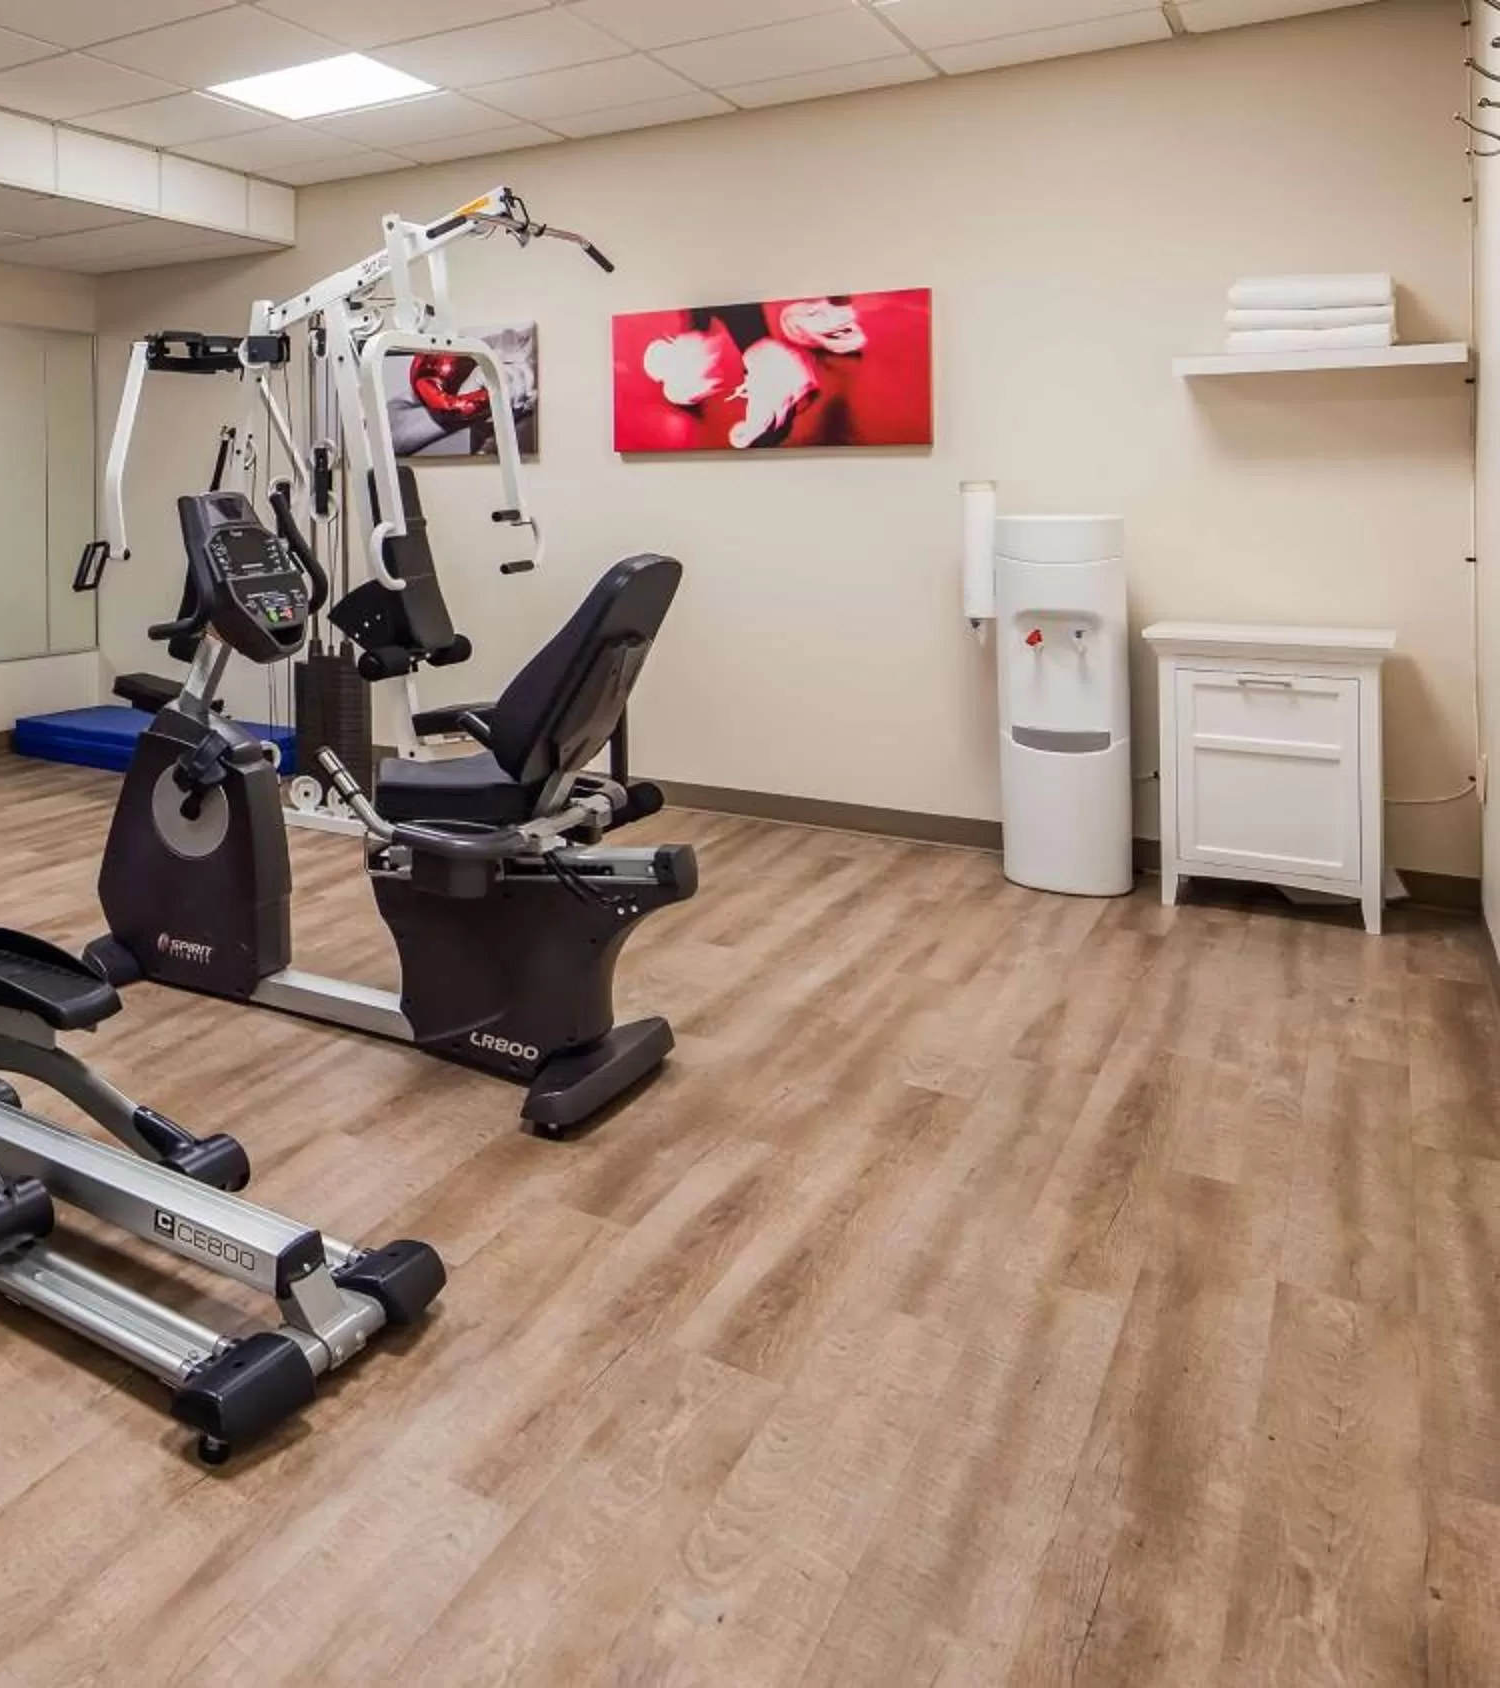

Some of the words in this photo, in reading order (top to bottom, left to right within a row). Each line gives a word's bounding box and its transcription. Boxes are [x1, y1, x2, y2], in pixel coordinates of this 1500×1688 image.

[171, 939, 213, 957] SPIRIT
[469, 1031, 539, 1061] LR800
[177, 1222, 255, 1271] CE800
